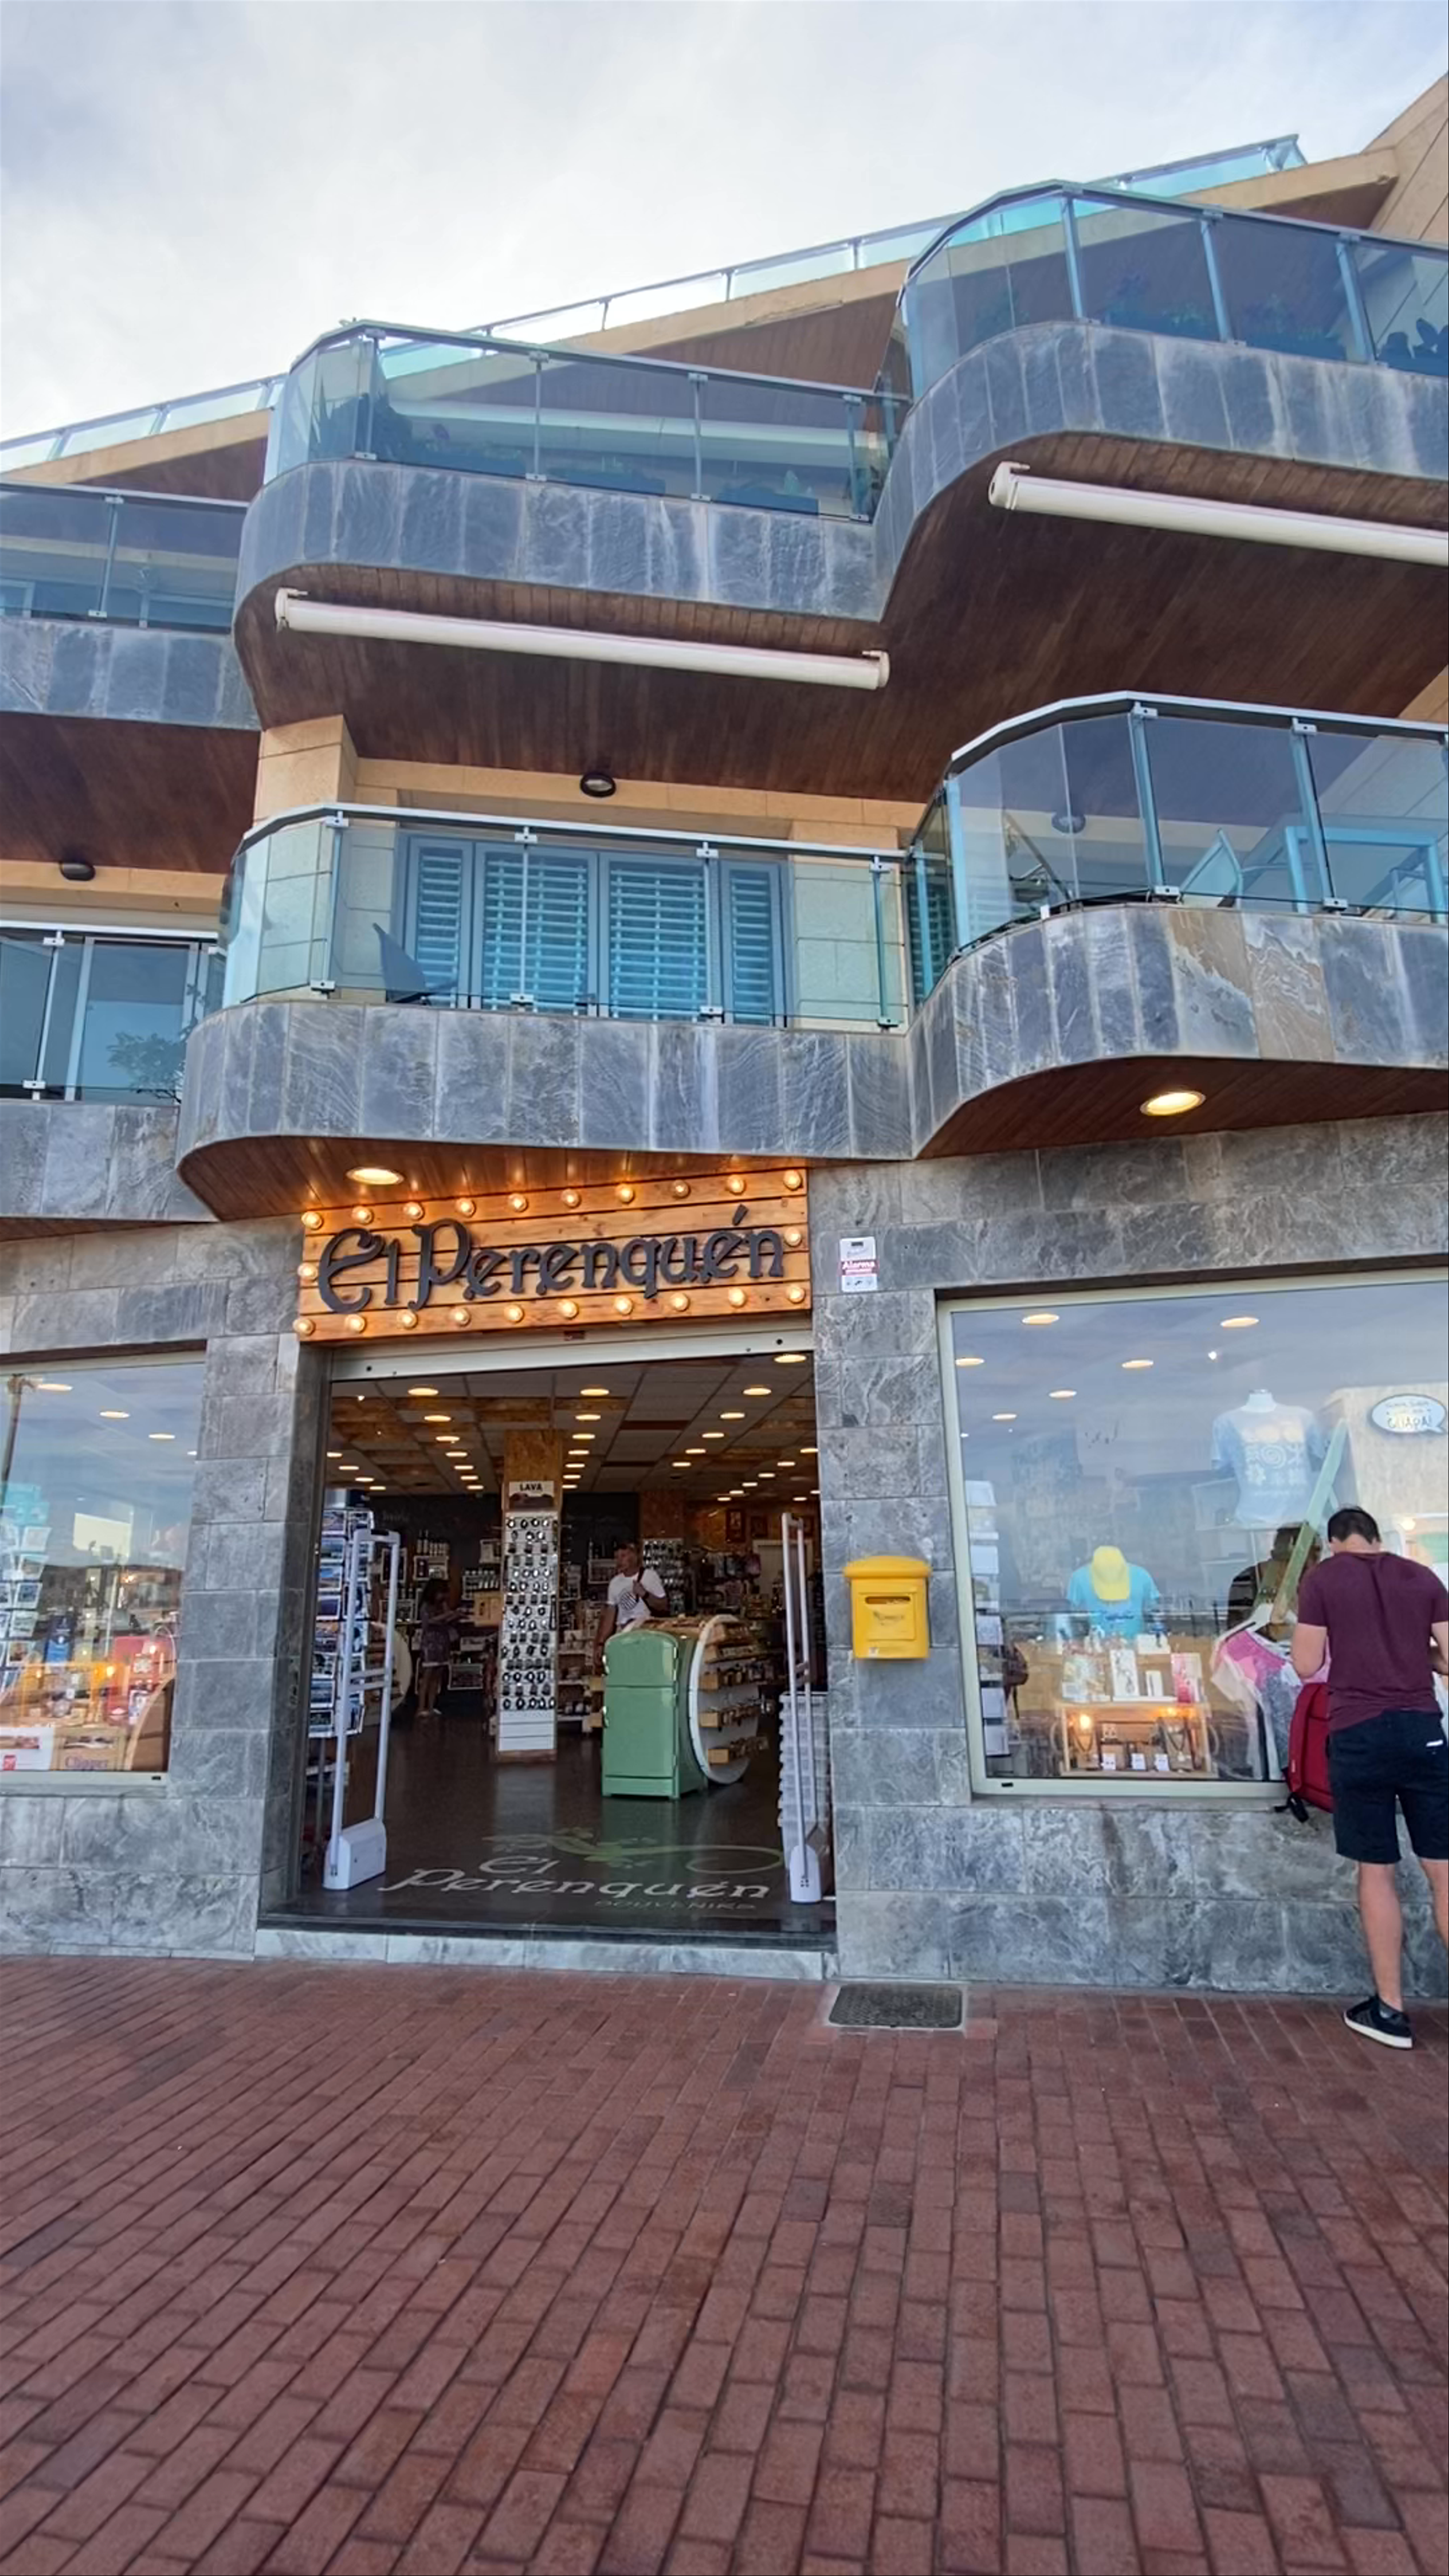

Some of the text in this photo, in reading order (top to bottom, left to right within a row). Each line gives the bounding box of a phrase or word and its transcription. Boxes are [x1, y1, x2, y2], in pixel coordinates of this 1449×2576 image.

[318, 1204, 784, 1314] El Perenquén
[520, 1483, 543, 1492] LAVA
[478, 1855, 560, 1875] El
[378, 1867, 770, 1899] Perenquén
